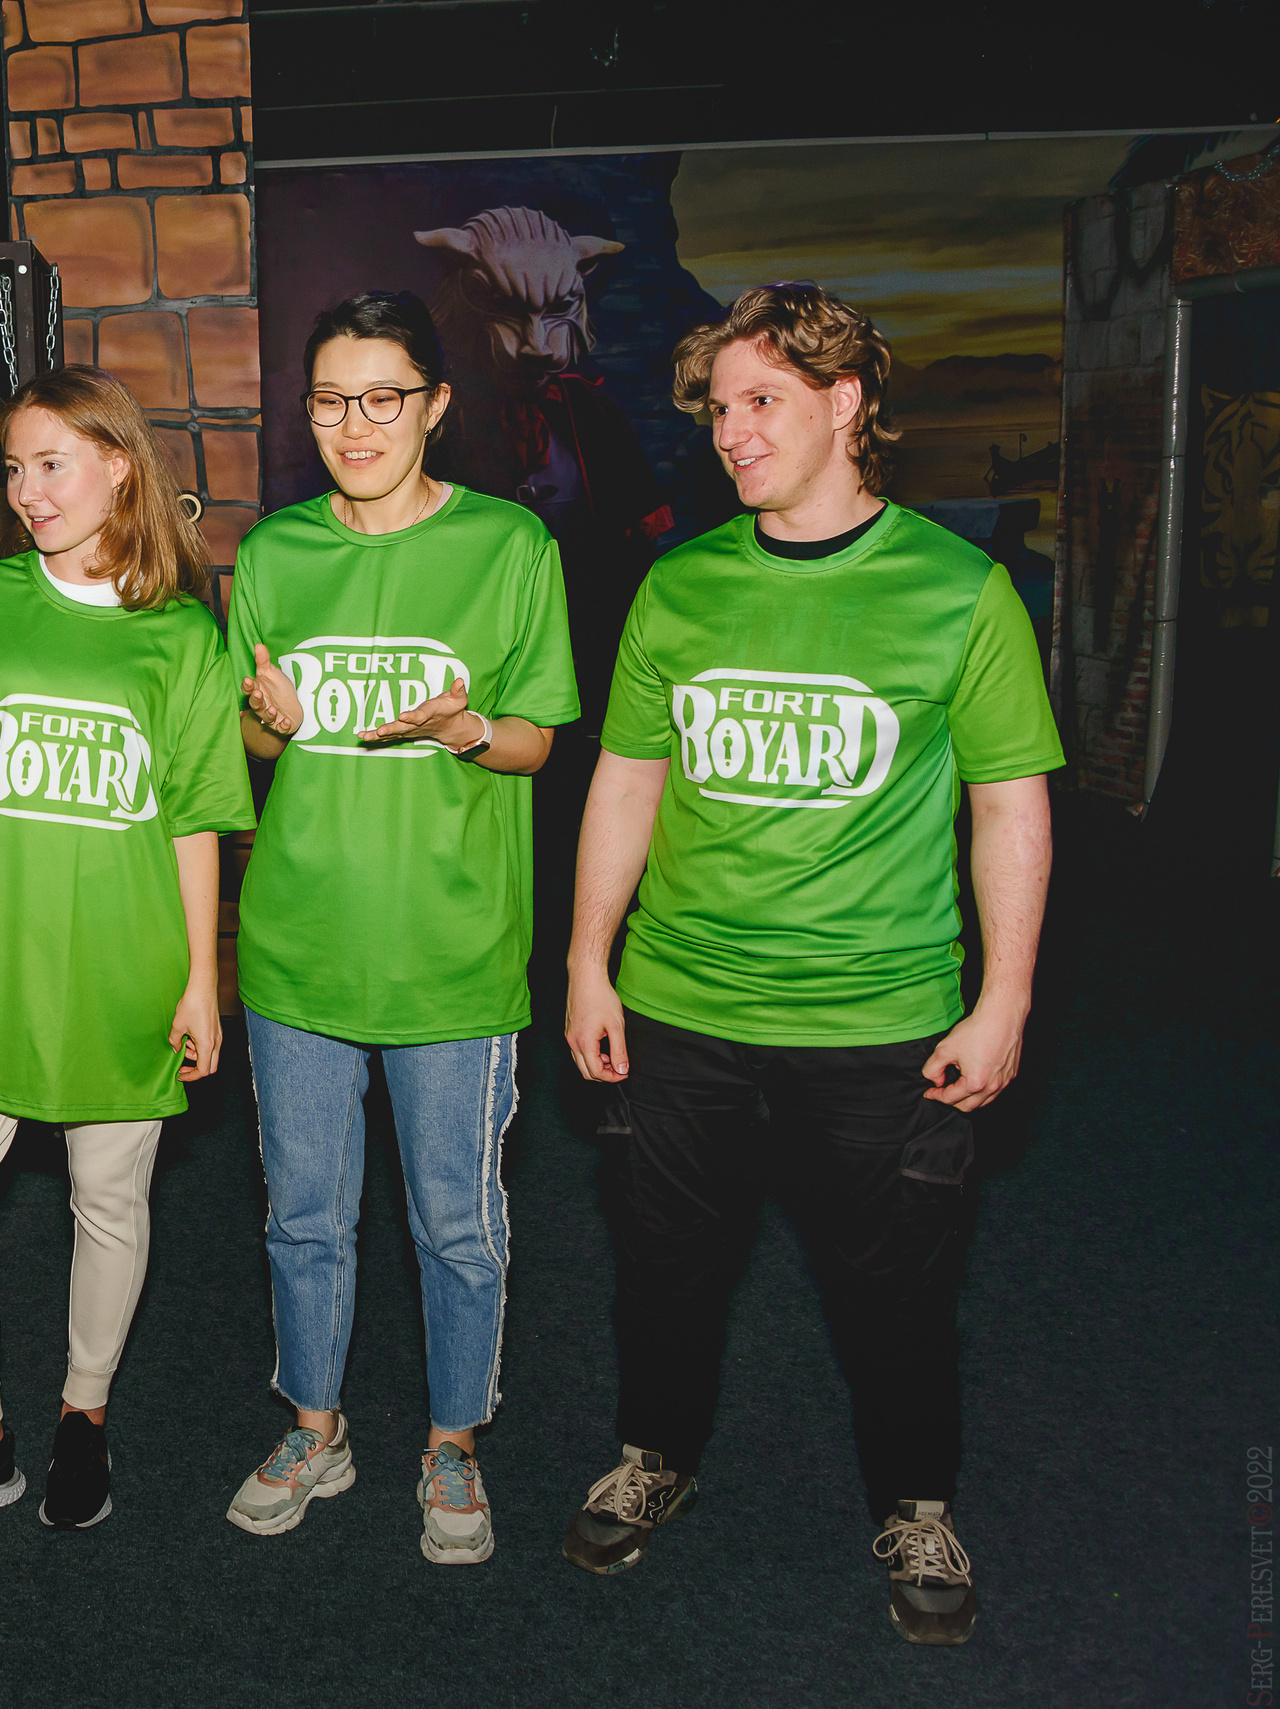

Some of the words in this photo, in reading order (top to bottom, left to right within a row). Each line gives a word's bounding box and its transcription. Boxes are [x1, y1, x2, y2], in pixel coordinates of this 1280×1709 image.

[325, 652, 417, 674] FORT
[719, 687, 831, 717] FORT
[21, 711, 118, 744] FORT
[672, 684, 900, 797] BOYARD
